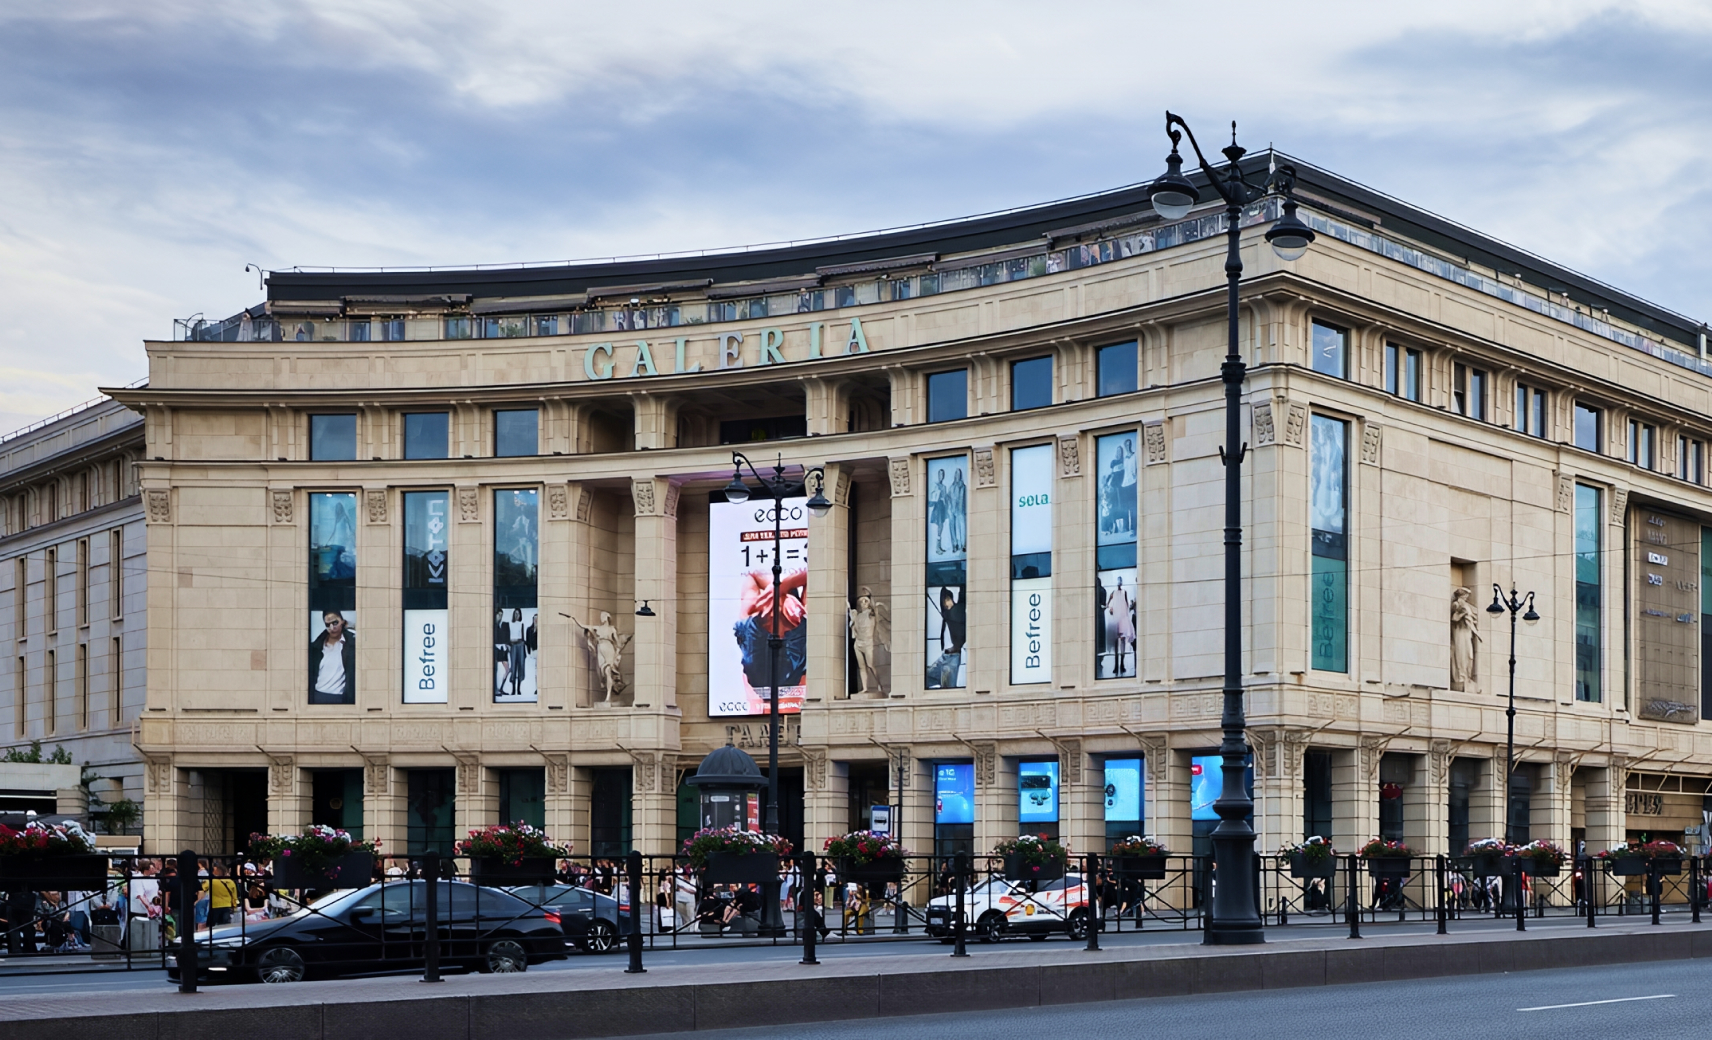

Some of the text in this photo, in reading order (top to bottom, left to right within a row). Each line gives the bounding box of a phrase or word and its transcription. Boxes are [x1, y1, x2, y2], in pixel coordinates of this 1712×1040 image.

[583, 317, 870, 381] GALERIA
[754, 506, 803, 523] ecco
[418, 622, 436, 690] Befree
[1025, 592, 1041, 669] Befree
